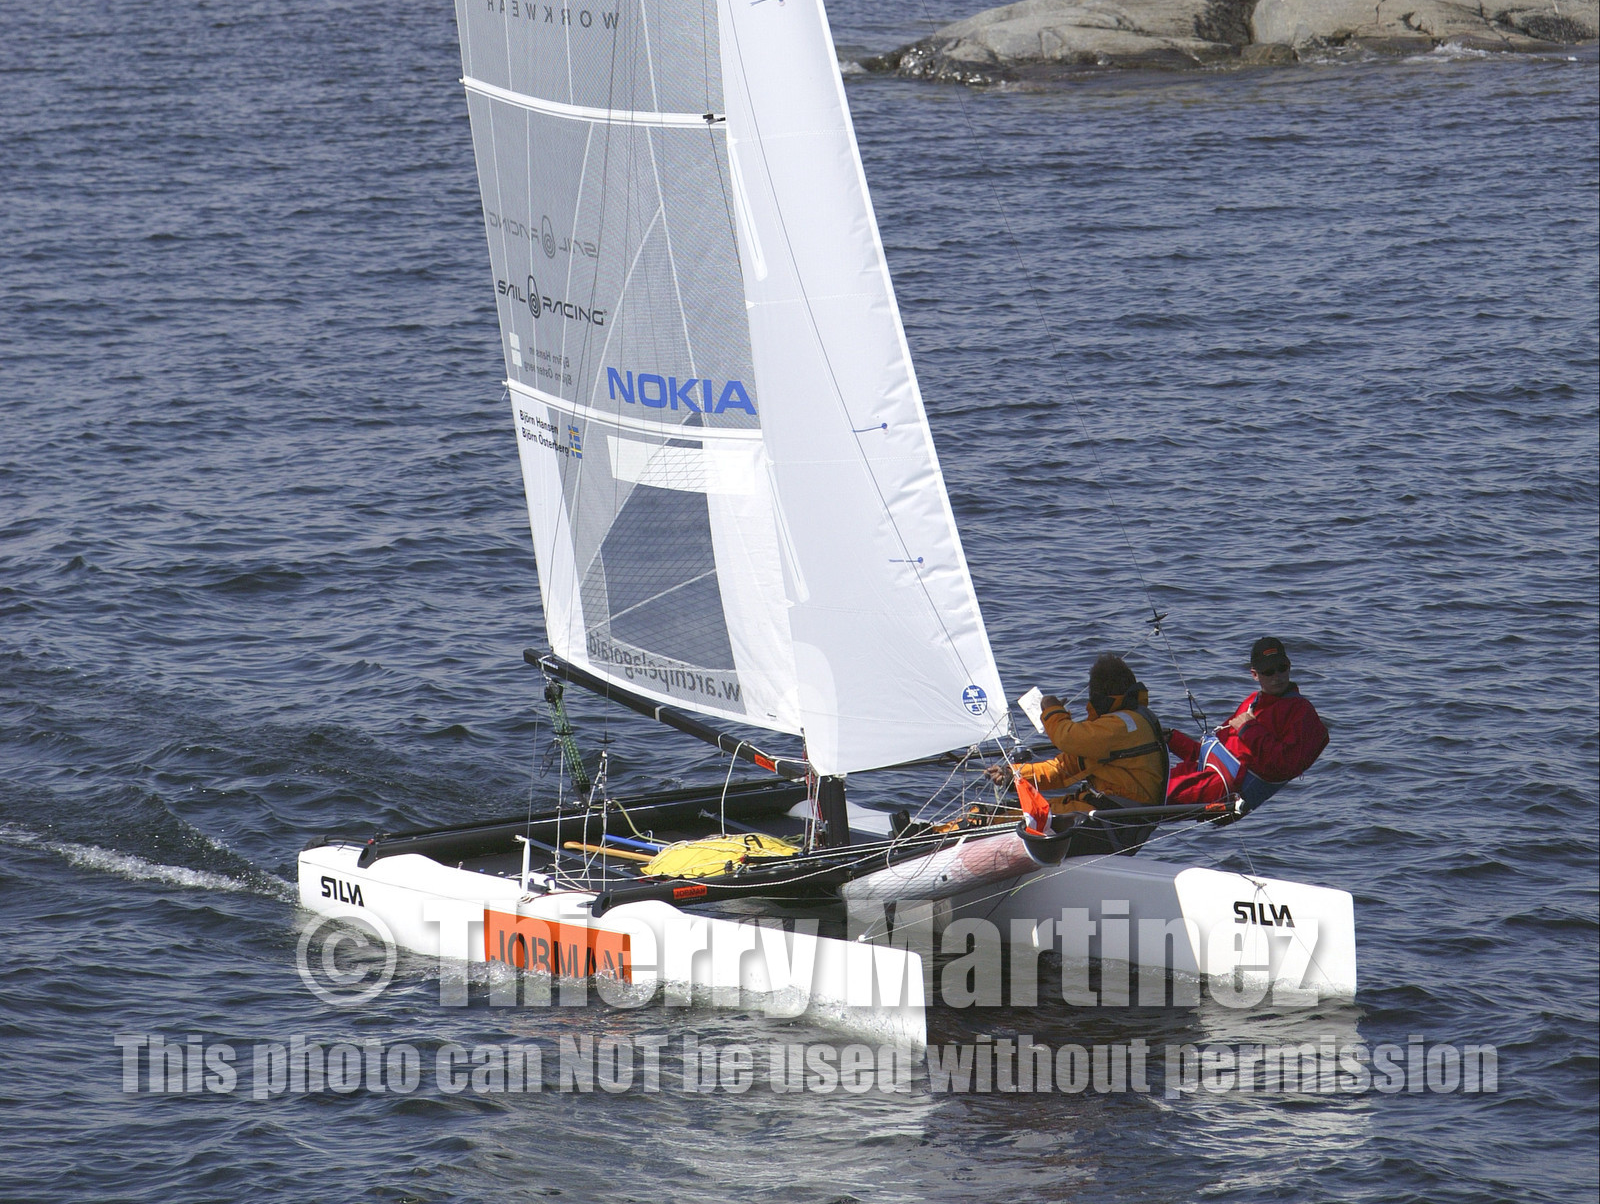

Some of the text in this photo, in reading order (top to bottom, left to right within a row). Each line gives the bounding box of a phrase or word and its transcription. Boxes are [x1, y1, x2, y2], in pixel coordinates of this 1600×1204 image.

[497, 279, 526, 303] SAIL
[606, 366, 757, 415] NOKIA
[519, 410, 559, 435] Björn Hansen
[521, 427, 569, 456] Björn Österberg
[321, 876, 365, 907] SILVA
[1233, 900, 1295, 929] SILVA
[491, 929, 624, 979] JOBMAN
